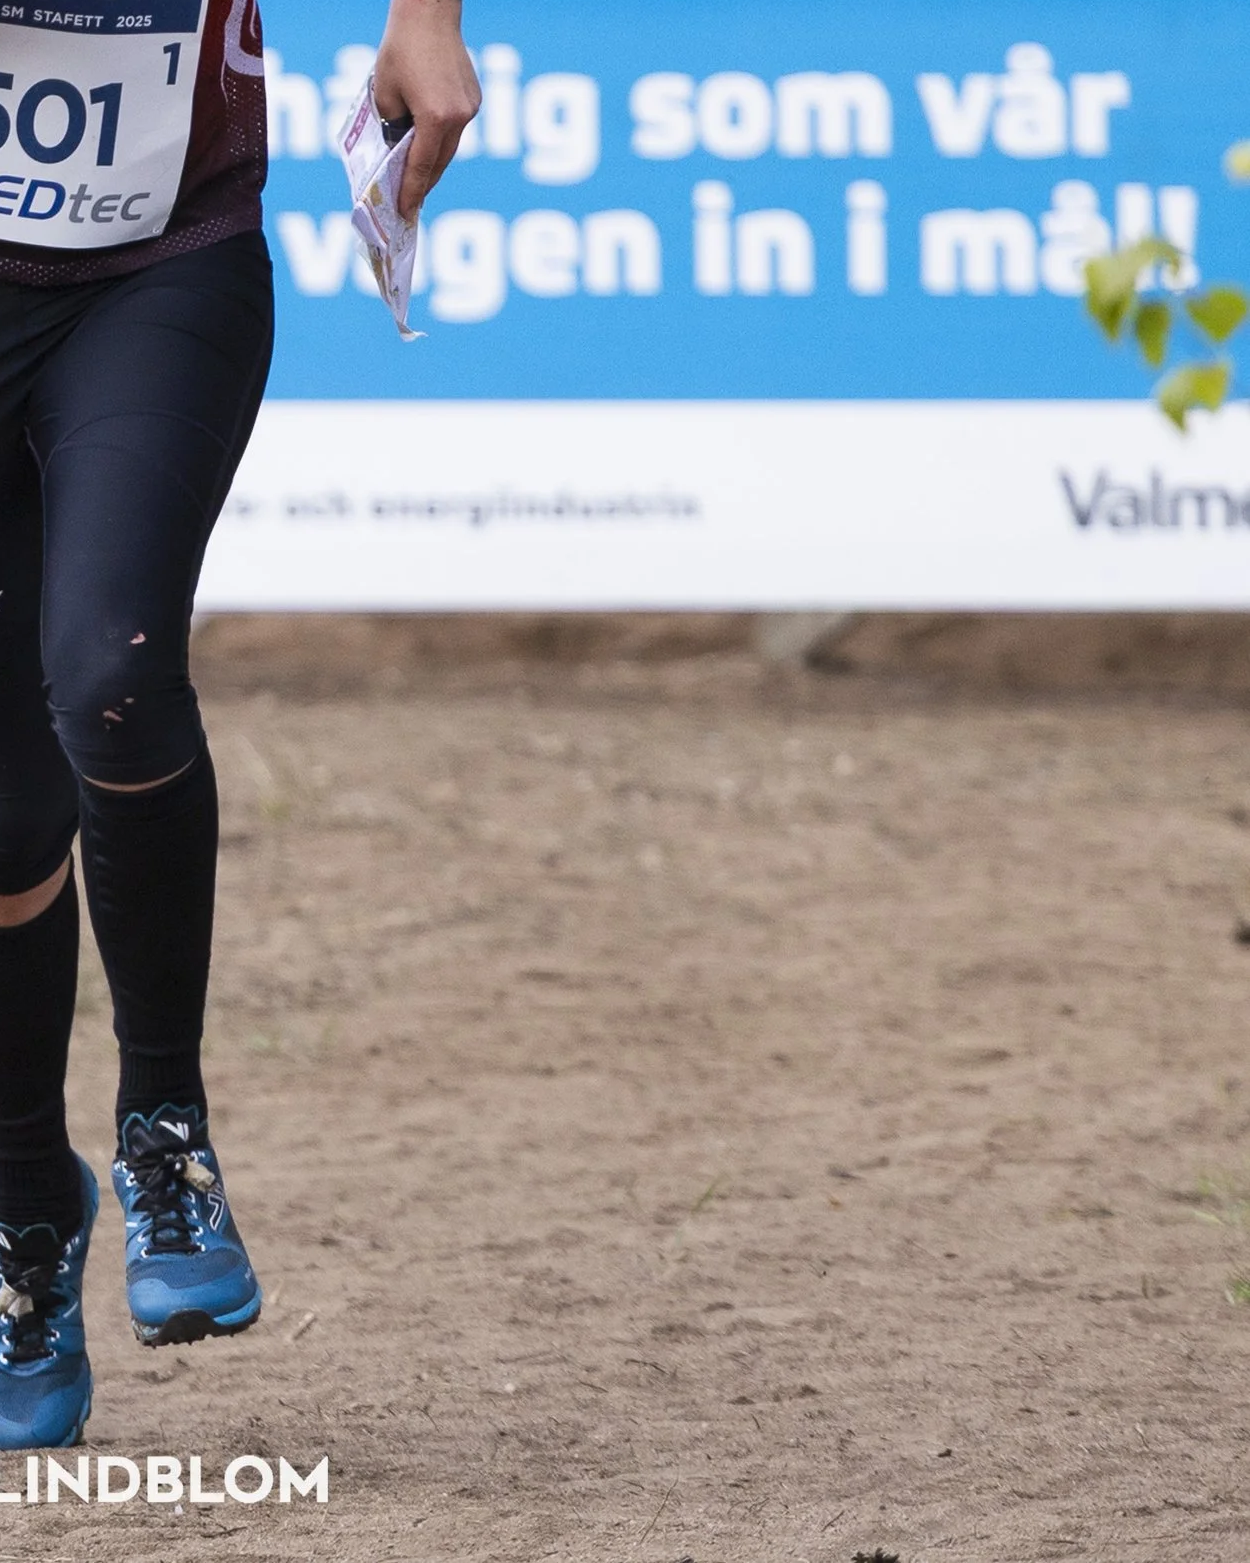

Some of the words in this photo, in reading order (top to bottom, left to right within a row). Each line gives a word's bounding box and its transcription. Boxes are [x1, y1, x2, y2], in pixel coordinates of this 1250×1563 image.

[0, 5, 25, 19] SM
[33, 9, 104, 28] STAFETT
[116, 15, 153, 28] 2025
[162, 42, 182, 85] 1
[630, 70, 893, 160] som
[915, 41, 1132, 160] vår
[692, 179, 817, 298] in
[845, 179, 889, 298] i
